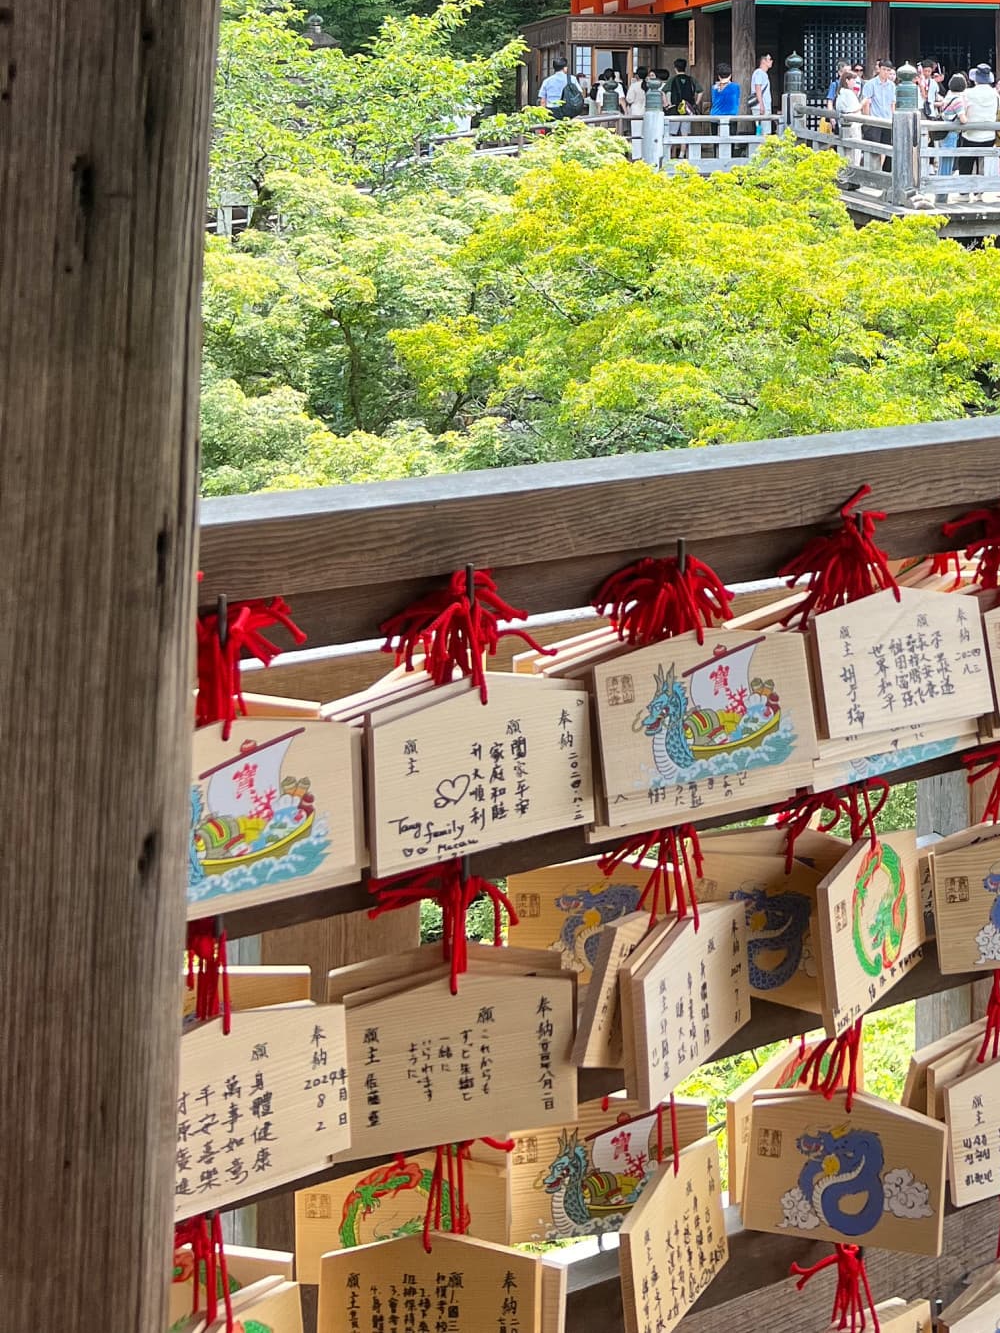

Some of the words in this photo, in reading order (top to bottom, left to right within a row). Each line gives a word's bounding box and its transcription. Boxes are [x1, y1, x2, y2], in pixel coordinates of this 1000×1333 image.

[868, 644, 896, 712] 世界和平
[506, 719, 522, 735] 願
[558, 708, 574, 750] 奉納
[403, 739, 419, 776] 願主
[489, 742, 509, 820] 家庭和睦
[424, 821, 465, 843] family
[477, 1006, 495, 1024] 願
[536, 995, 554, 1041] 奉納
[251, 1042, 269, 1061] 願
[311, 1025, 327, 1069] 奉納
[363, 1027, 380, 1066] 願主
[480, 1029, 493, 1095] これからも
[317, 1093, 325, 1108] 8
[972, 1094, 985, 1127] 願主
[190, 1084, 221, 1194] 平安喜樂
[221, 1074, 248, 1185] 萬事如意
[249, 1070, 277, 1173] 身體健康
[315, 1121, 326, 1132] 2
[339, 1112, 347, 1126] 日
[347, 1272, 361, 1310] 願主
[448, 1272, 464, 1289] 願
[501, 1270, 518, 1316] 奉納
